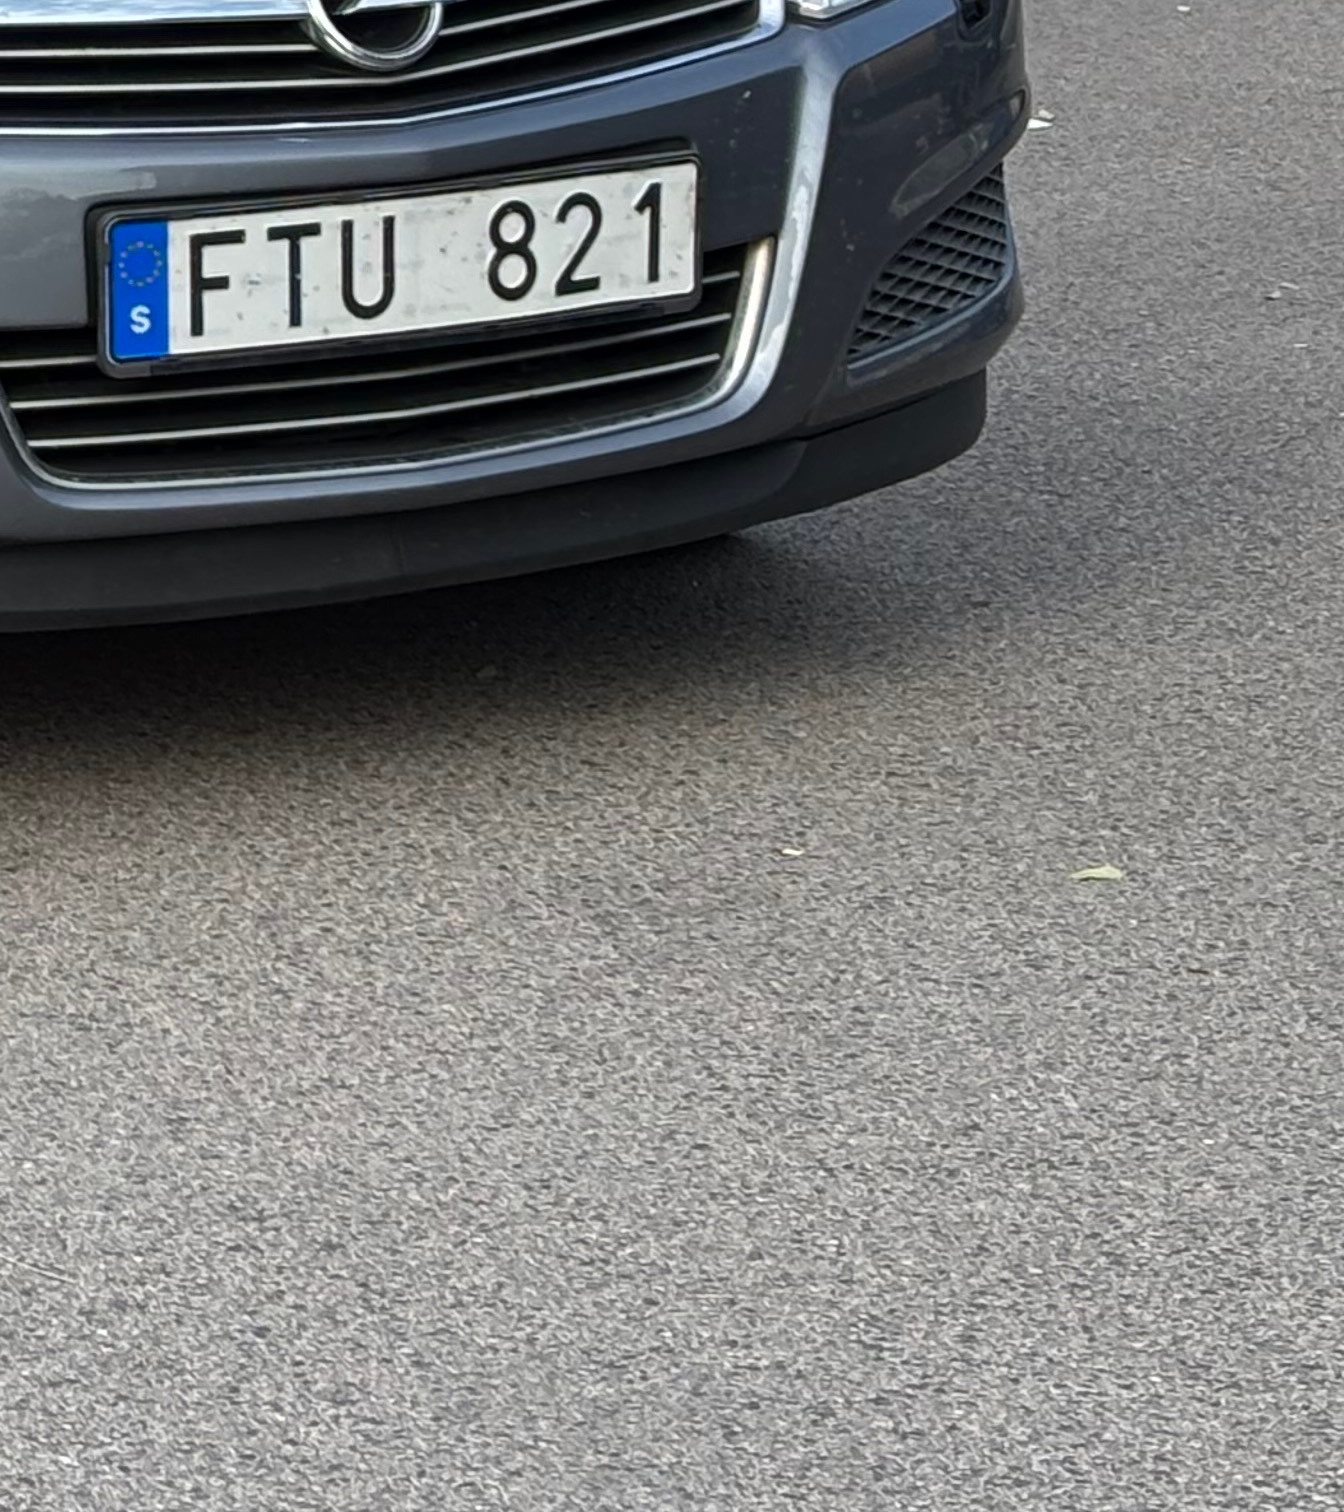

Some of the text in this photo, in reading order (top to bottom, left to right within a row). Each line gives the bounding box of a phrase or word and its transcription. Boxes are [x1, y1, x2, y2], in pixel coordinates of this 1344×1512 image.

[189, 182, 662, 337] FTU 821
[130, 305, 151, 334] S
